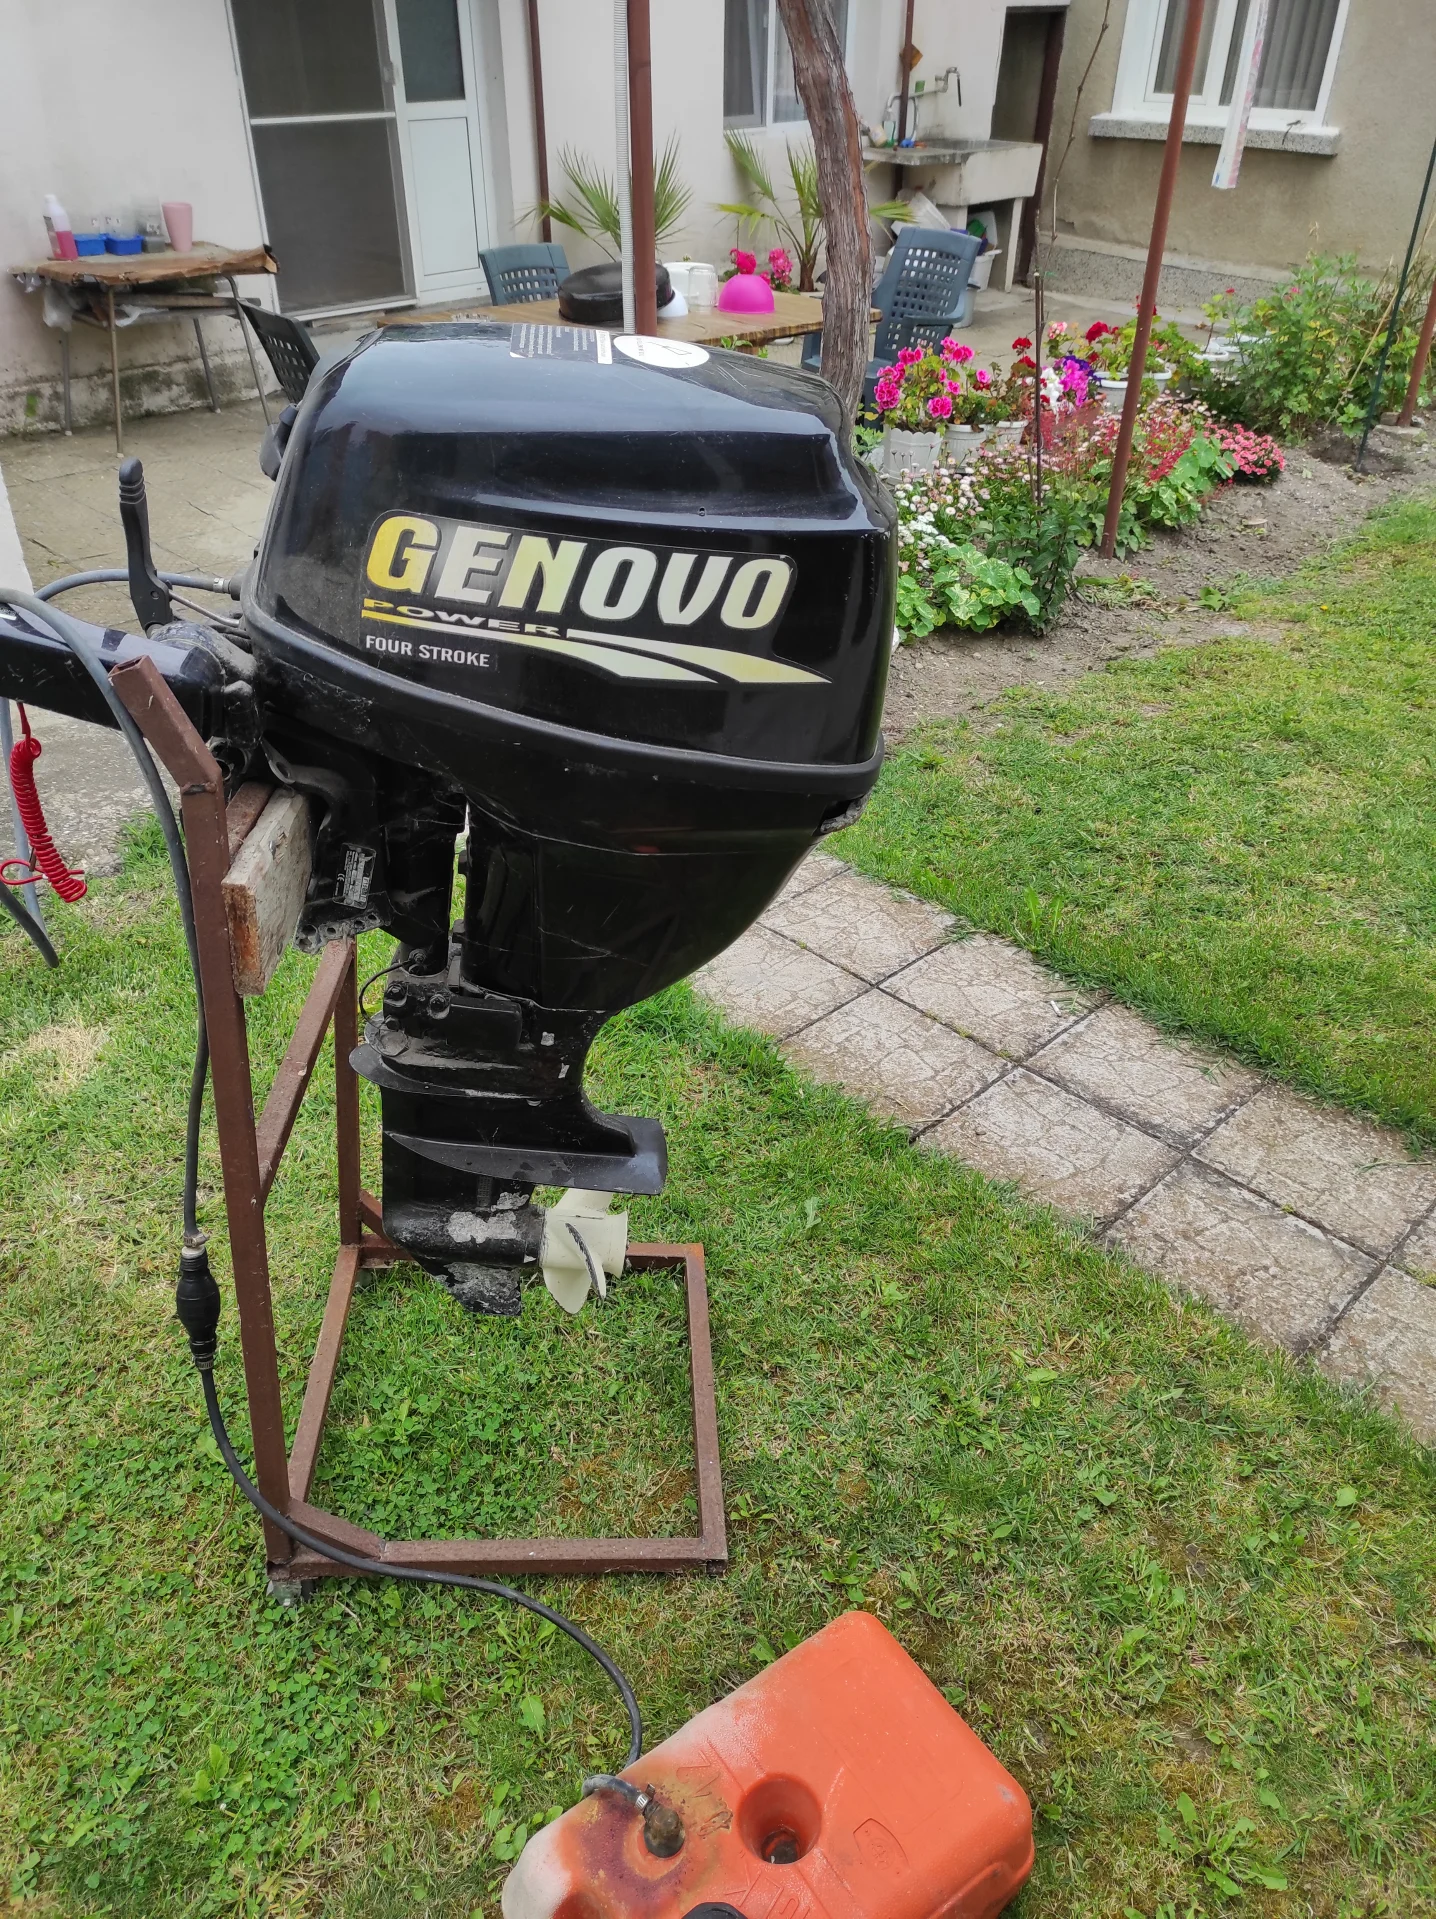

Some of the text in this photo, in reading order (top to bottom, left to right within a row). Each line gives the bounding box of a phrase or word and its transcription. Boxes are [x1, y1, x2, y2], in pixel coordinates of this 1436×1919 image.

[366, 516, 791, 630] GENOVO
[363, 598, 561, 637] POWER
[366, 635, 491, 668] FOUR STROKE
